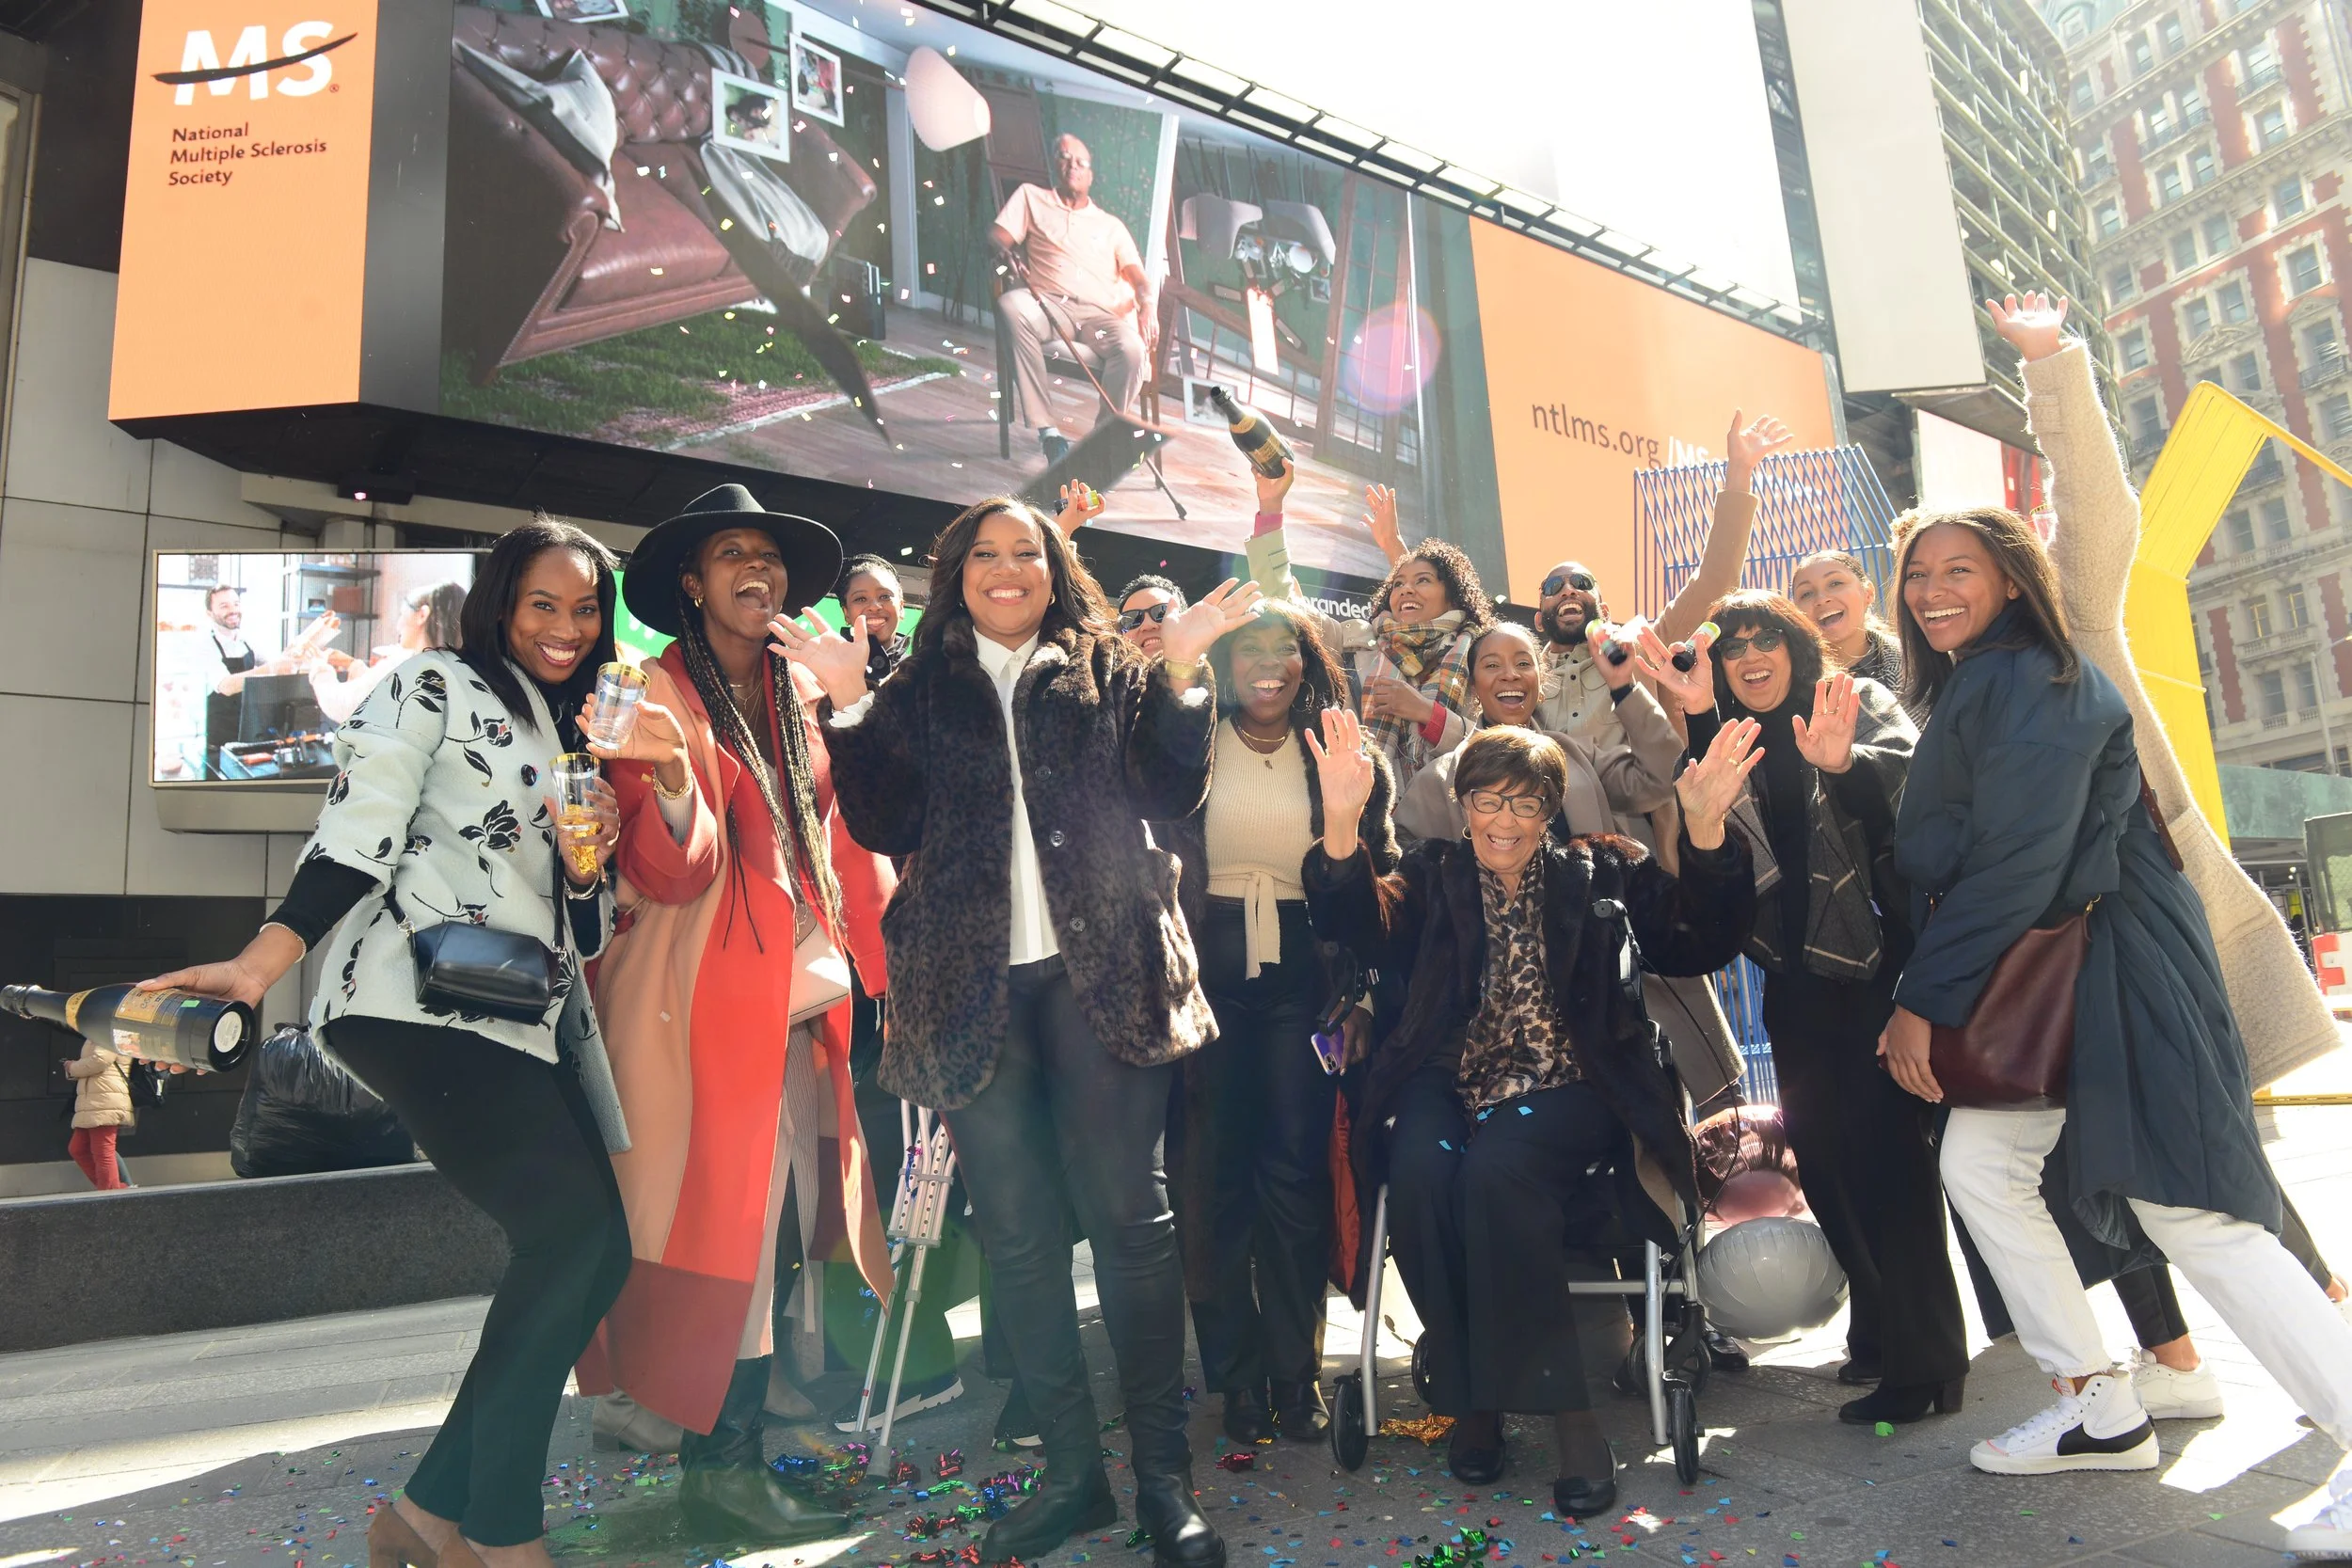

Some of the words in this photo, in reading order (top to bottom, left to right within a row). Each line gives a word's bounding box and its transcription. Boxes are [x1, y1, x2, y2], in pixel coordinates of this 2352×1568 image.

[174, 21, 334, 105] MS
[172, 122, 249, 142] National
[170, 144, 246, 165] Multiple
[250, 138, 327, 158] Sclerosis
[168, 170, 233, 187] Society
